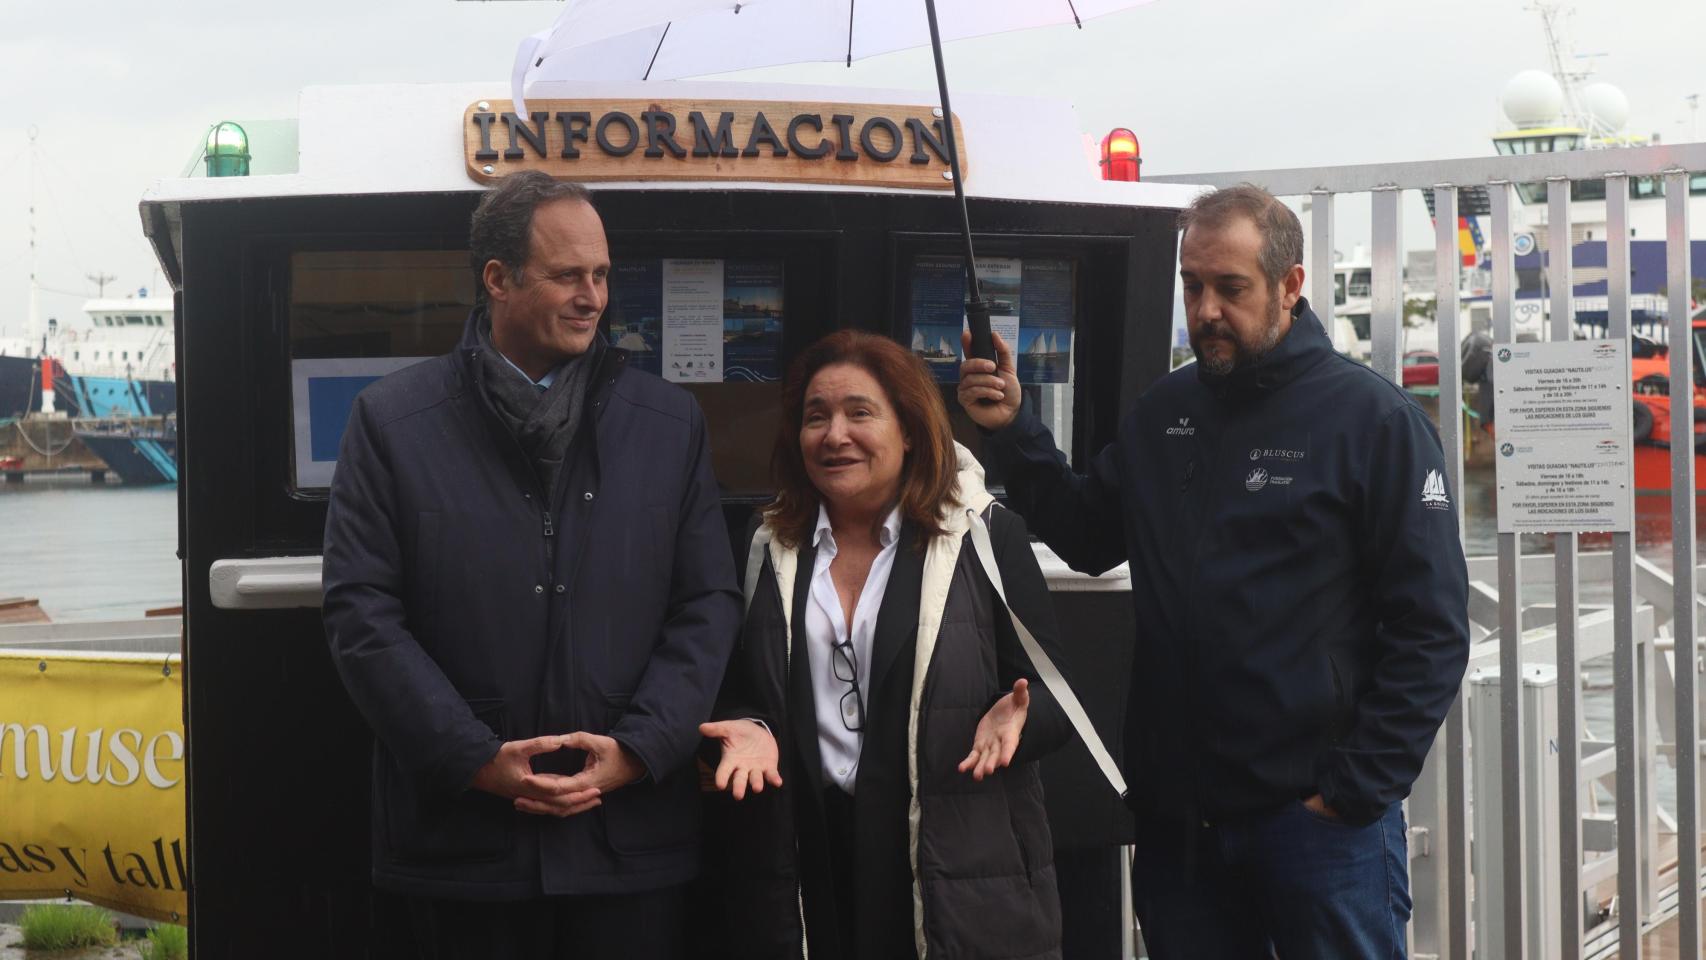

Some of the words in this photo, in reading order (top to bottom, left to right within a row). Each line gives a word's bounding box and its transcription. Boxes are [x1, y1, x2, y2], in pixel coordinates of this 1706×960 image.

[473, 110, 952, 165] INFORMACION
[1263, 449, 1305, 459] BLUSCUS
[58, 846, 88, 888] y
